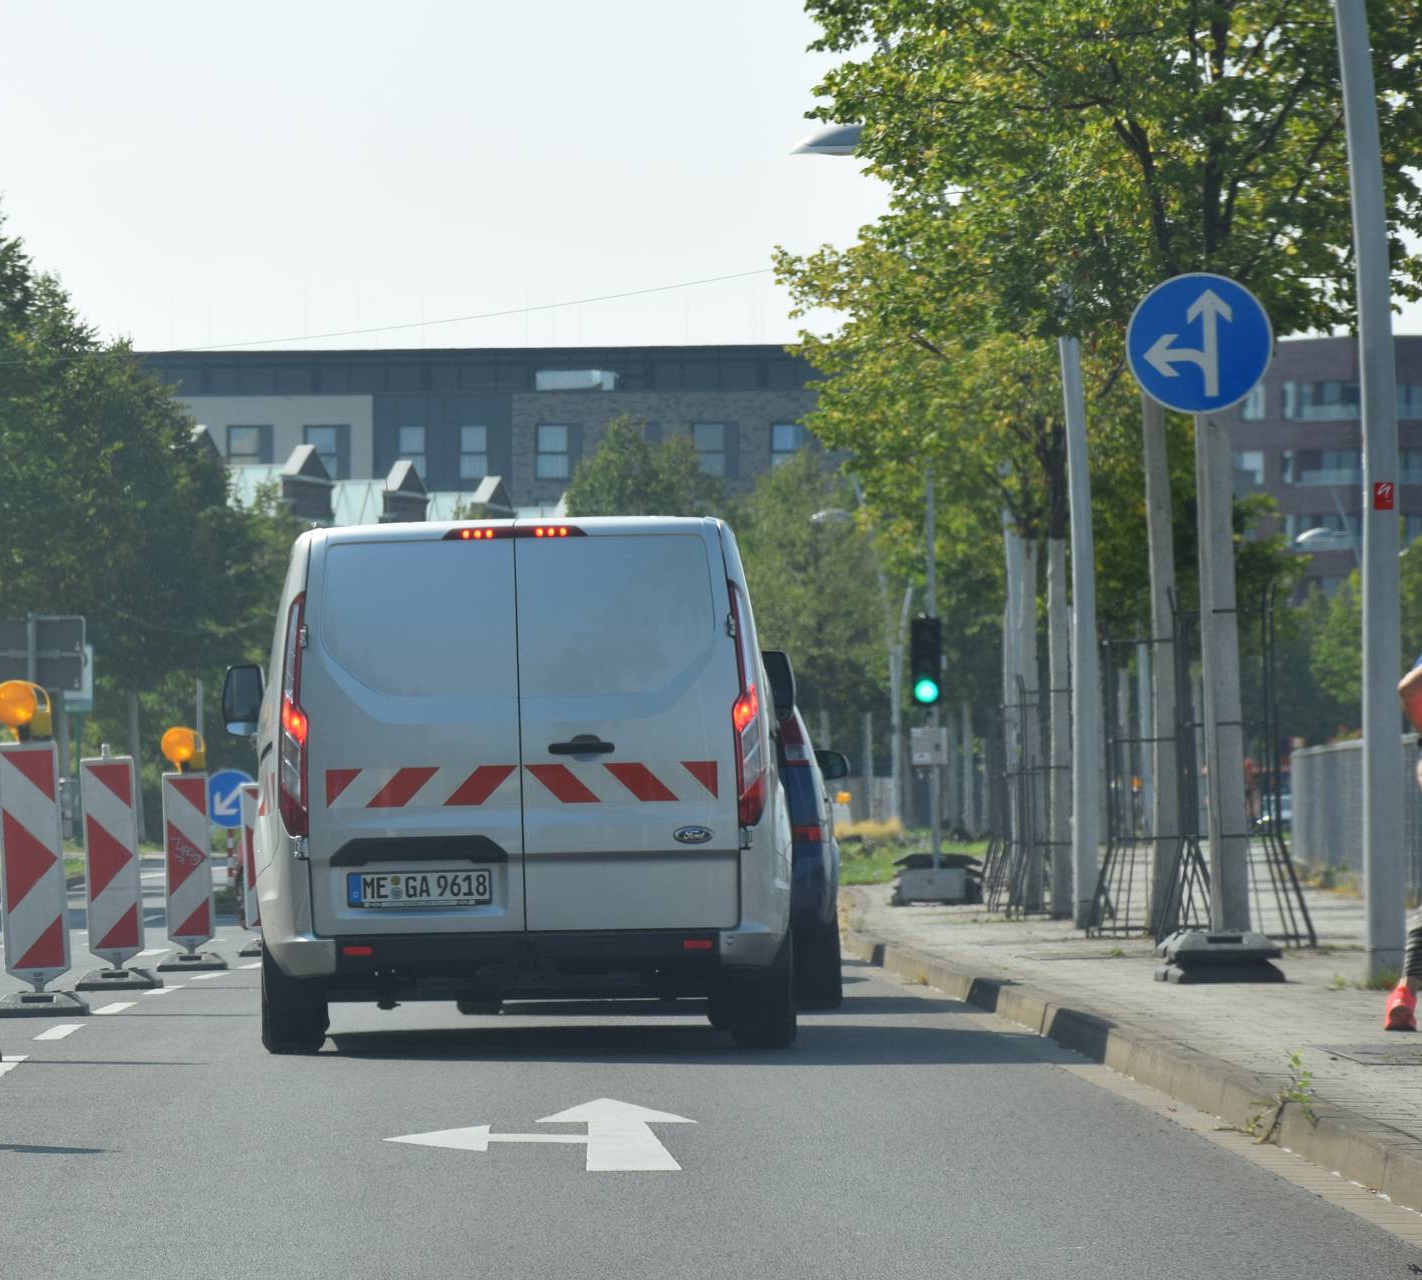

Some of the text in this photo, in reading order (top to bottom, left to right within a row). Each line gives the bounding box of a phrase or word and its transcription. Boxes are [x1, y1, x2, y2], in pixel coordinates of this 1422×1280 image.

[362, 874, 488, 899] ME GA 9618
